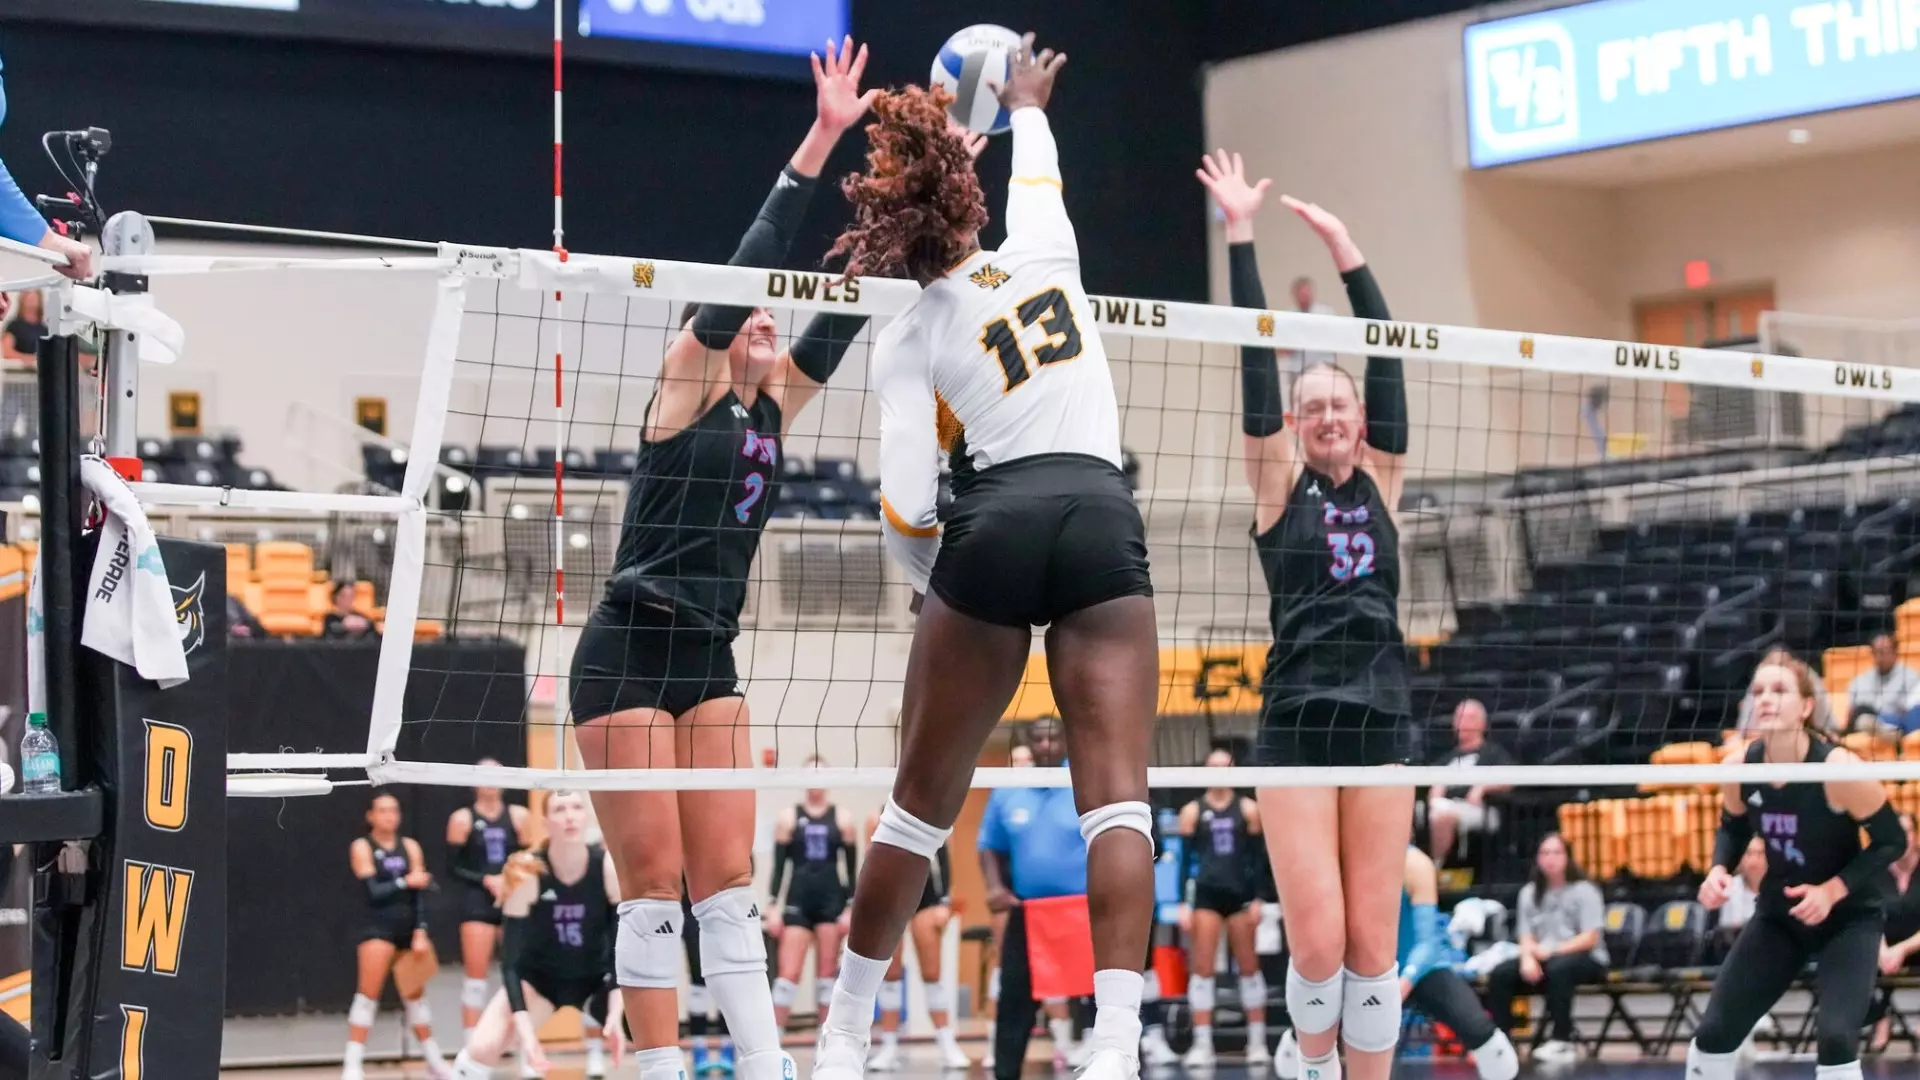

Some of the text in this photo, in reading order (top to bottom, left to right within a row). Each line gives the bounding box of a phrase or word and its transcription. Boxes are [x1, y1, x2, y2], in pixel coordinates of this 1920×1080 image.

[1598, 14, 1772, 102] FIFTH
[767, 271, 861, 303] OWLS
[978, 286, 1083, 395] 13
[1366, 323, 1439, 350] OWLS
[1615, 345, 1680, 371] OWLS
[1835, 365, 1893, 390] OWLS
[734, 472, 764, 524] 2
[1327, 531, 1375, 581] 32
